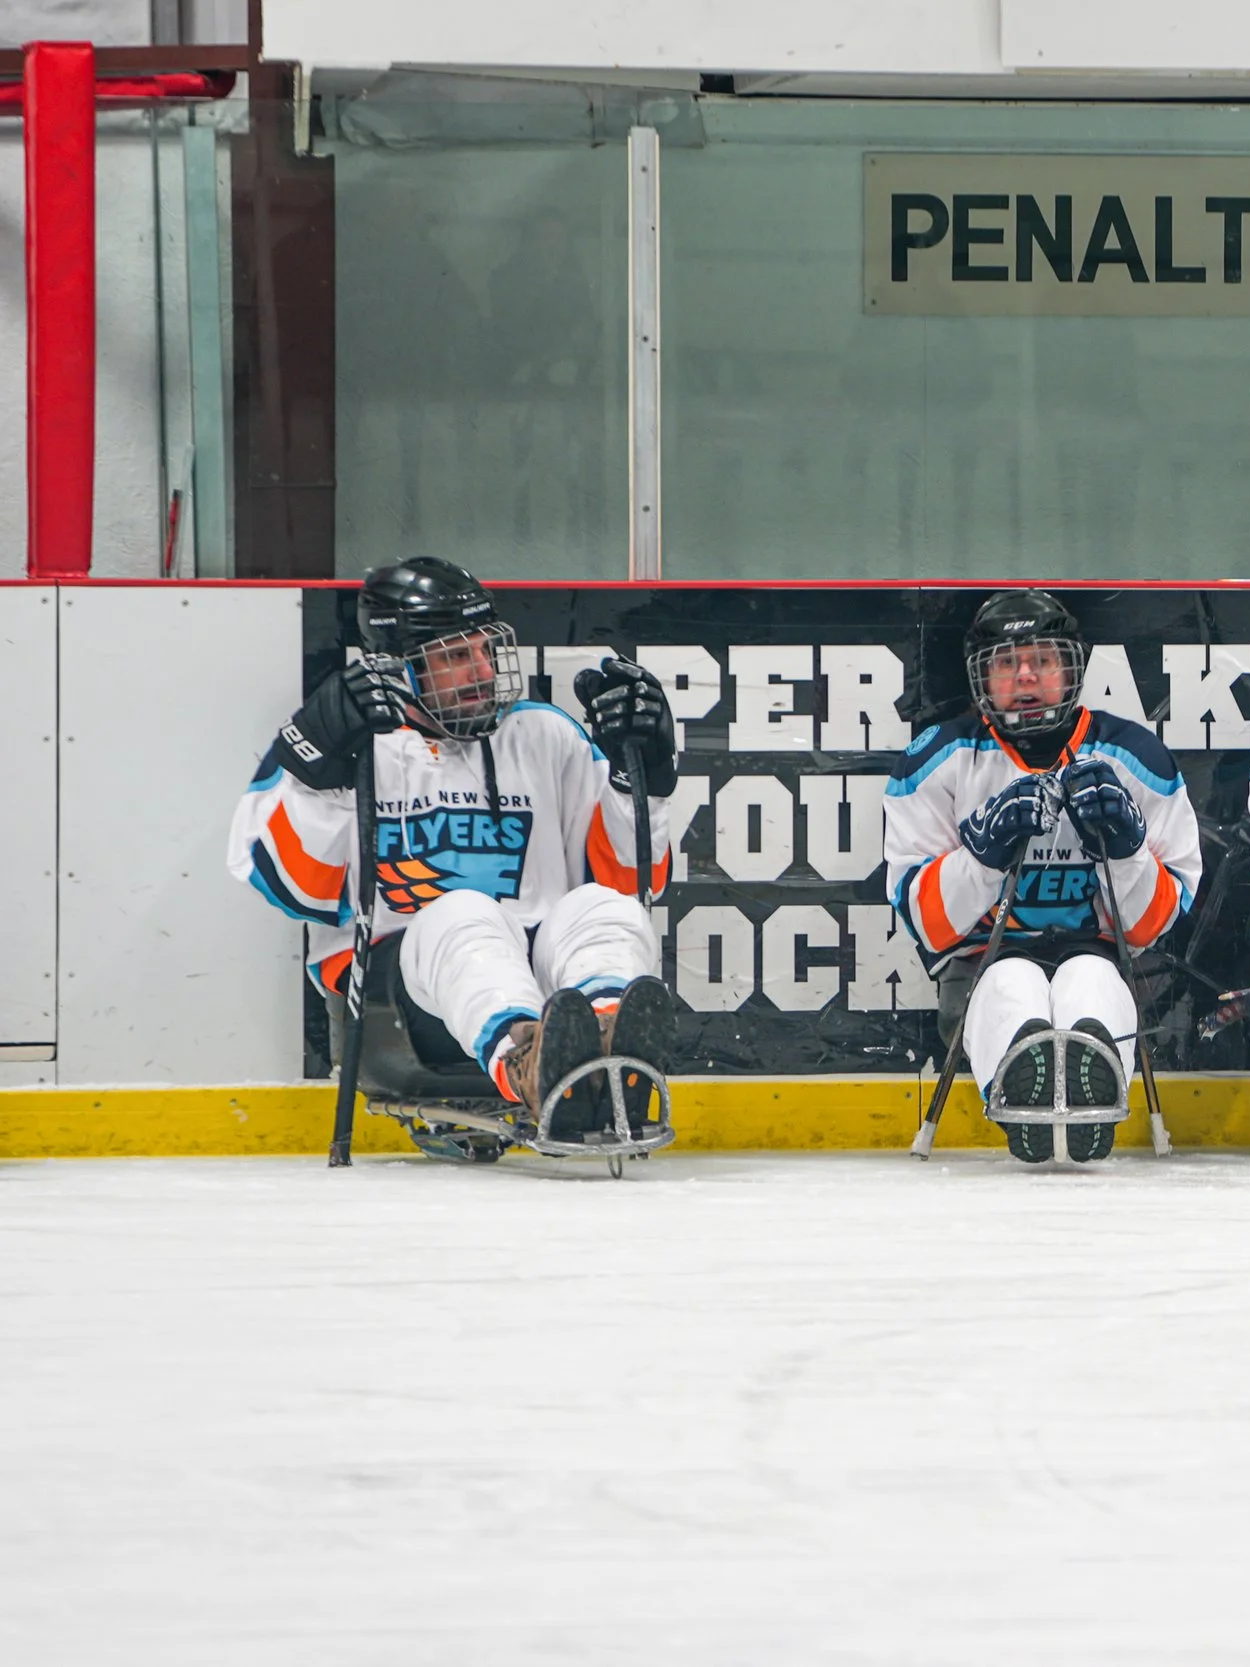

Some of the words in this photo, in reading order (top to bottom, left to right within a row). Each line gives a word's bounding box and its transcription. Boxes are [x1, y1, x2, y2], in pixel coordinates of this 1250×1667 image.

[438, 790, 478, 804] NEW
[484, 794, 534, 810] ORK
[377, 812, 525, 857] FLYERS
